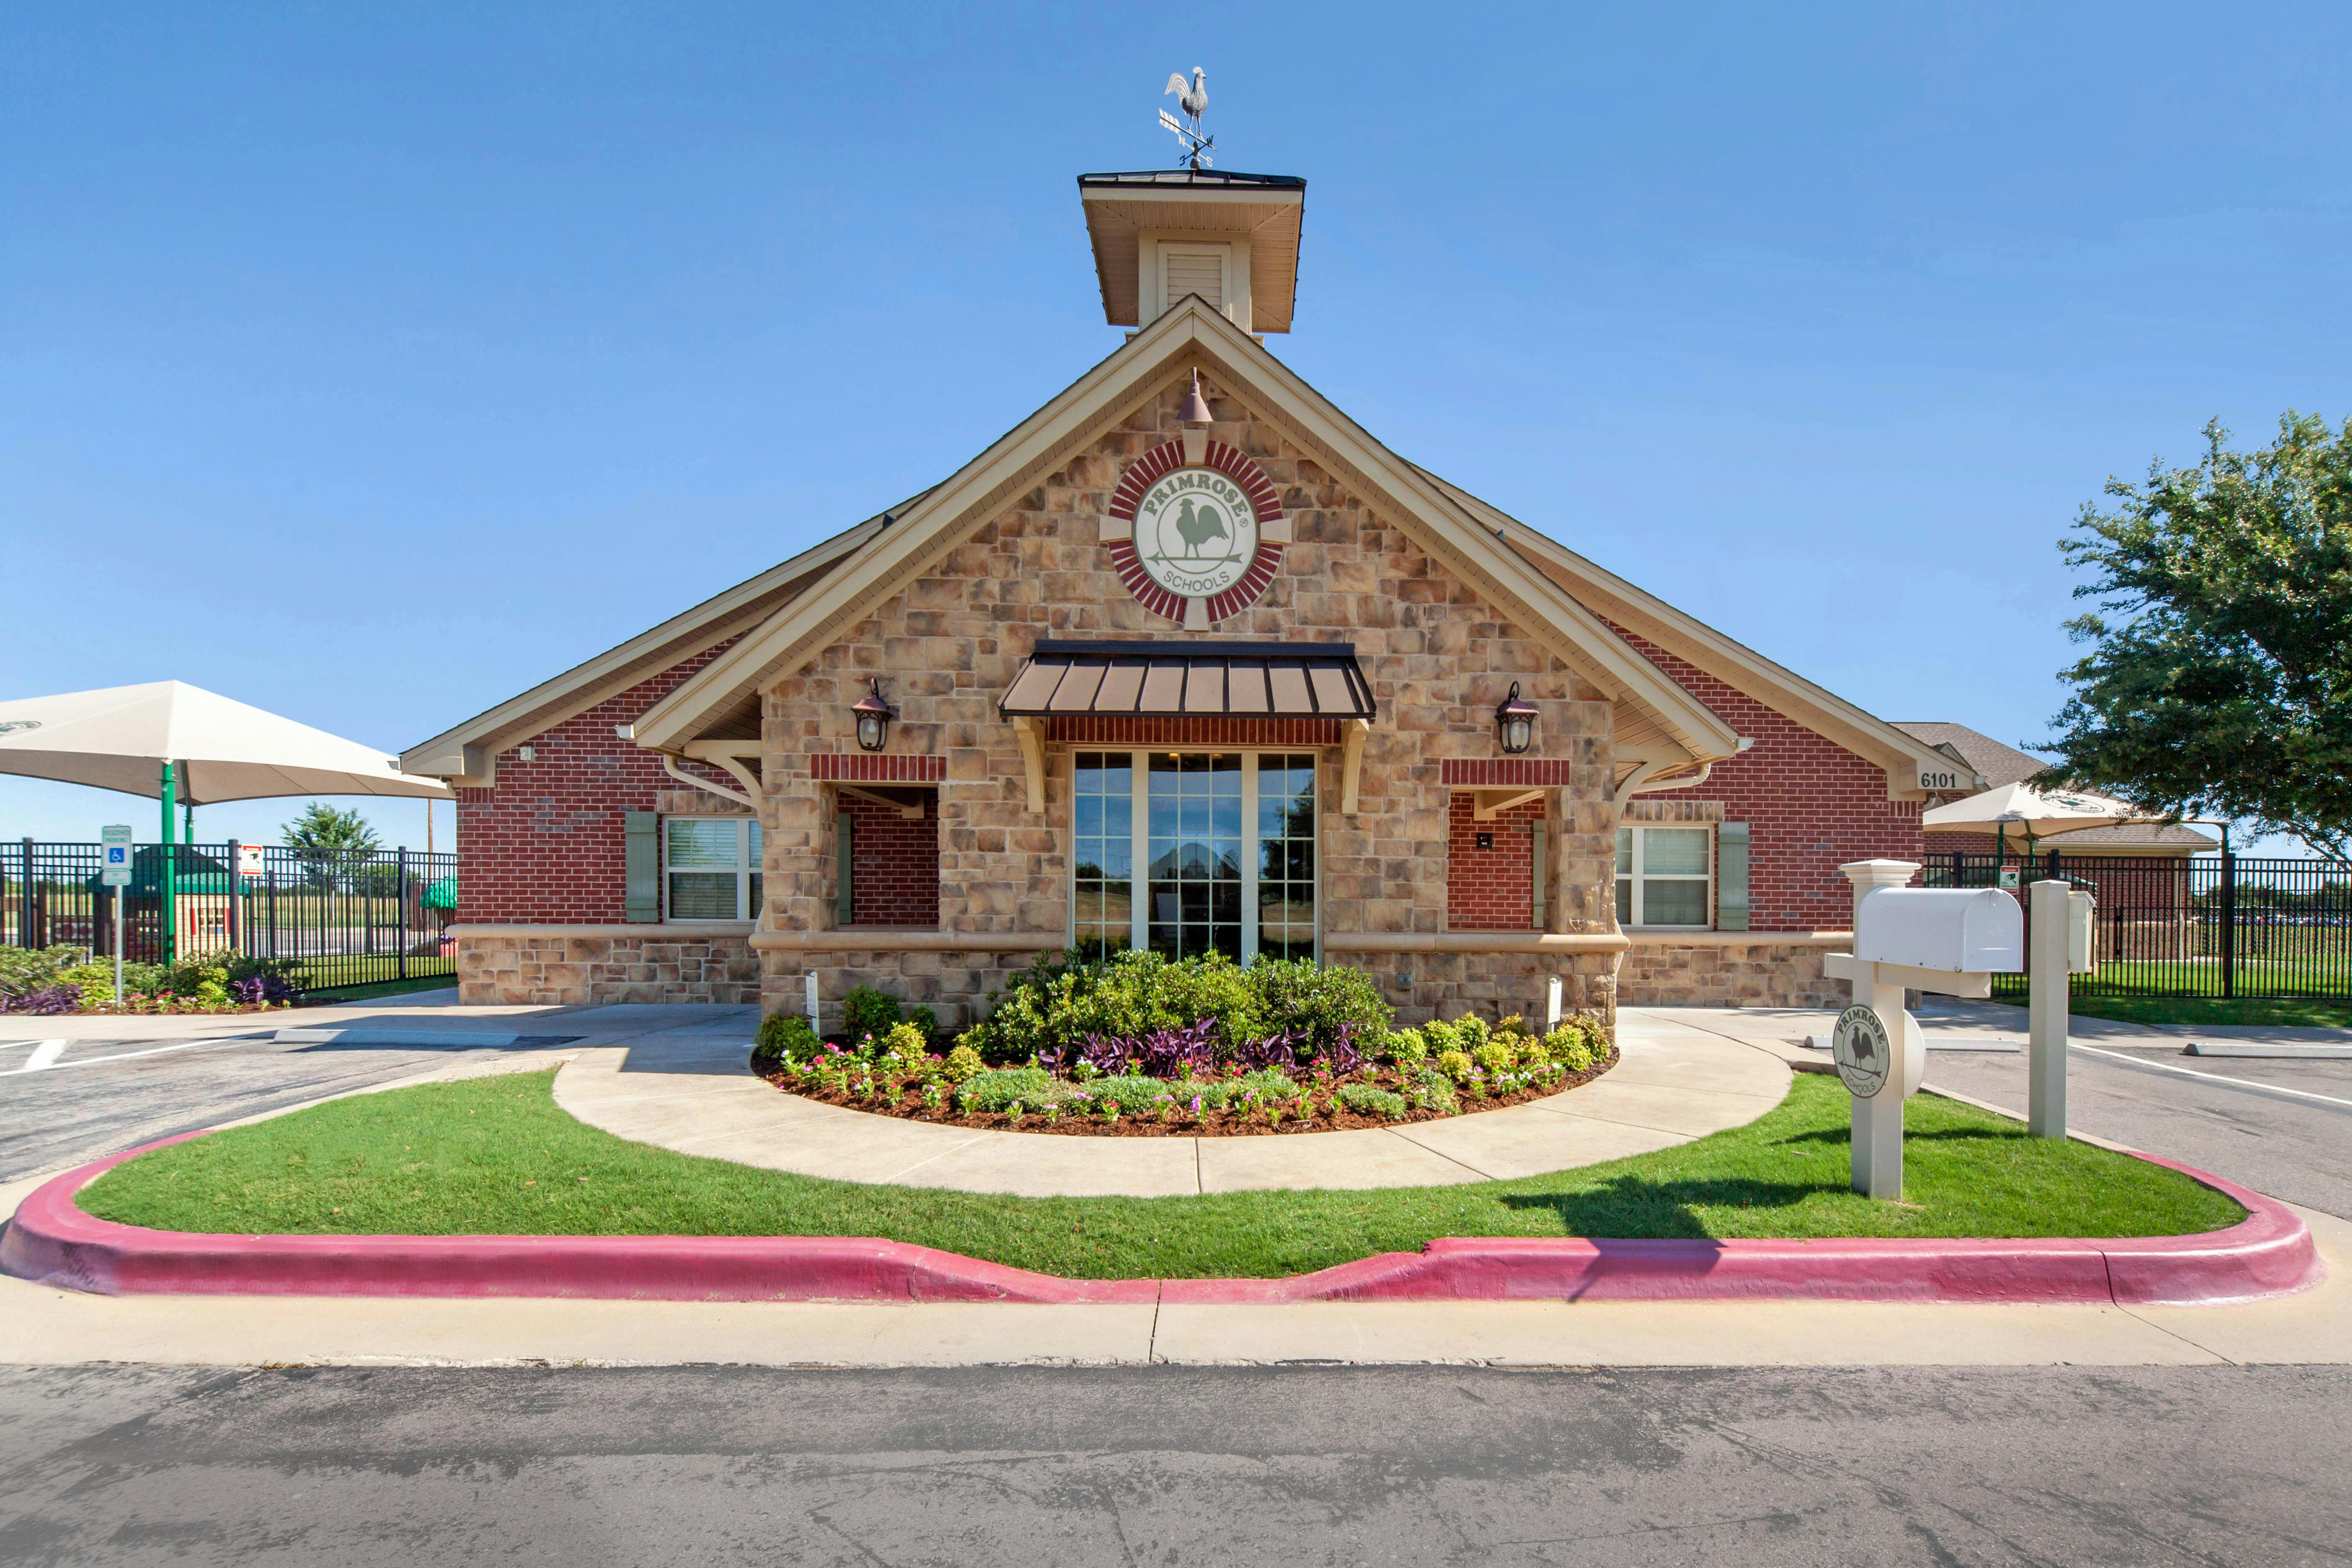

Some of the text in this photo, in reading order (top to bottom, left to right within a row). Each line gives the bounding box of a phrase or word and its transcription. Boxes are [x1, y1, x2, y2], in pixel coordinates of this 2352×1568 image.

[1163, 571, 1230, 592] SCHOOLS
[1921, 772, 1956, 788] 6101
[1845, 1074, 1875, 1093] SCHOOLS
